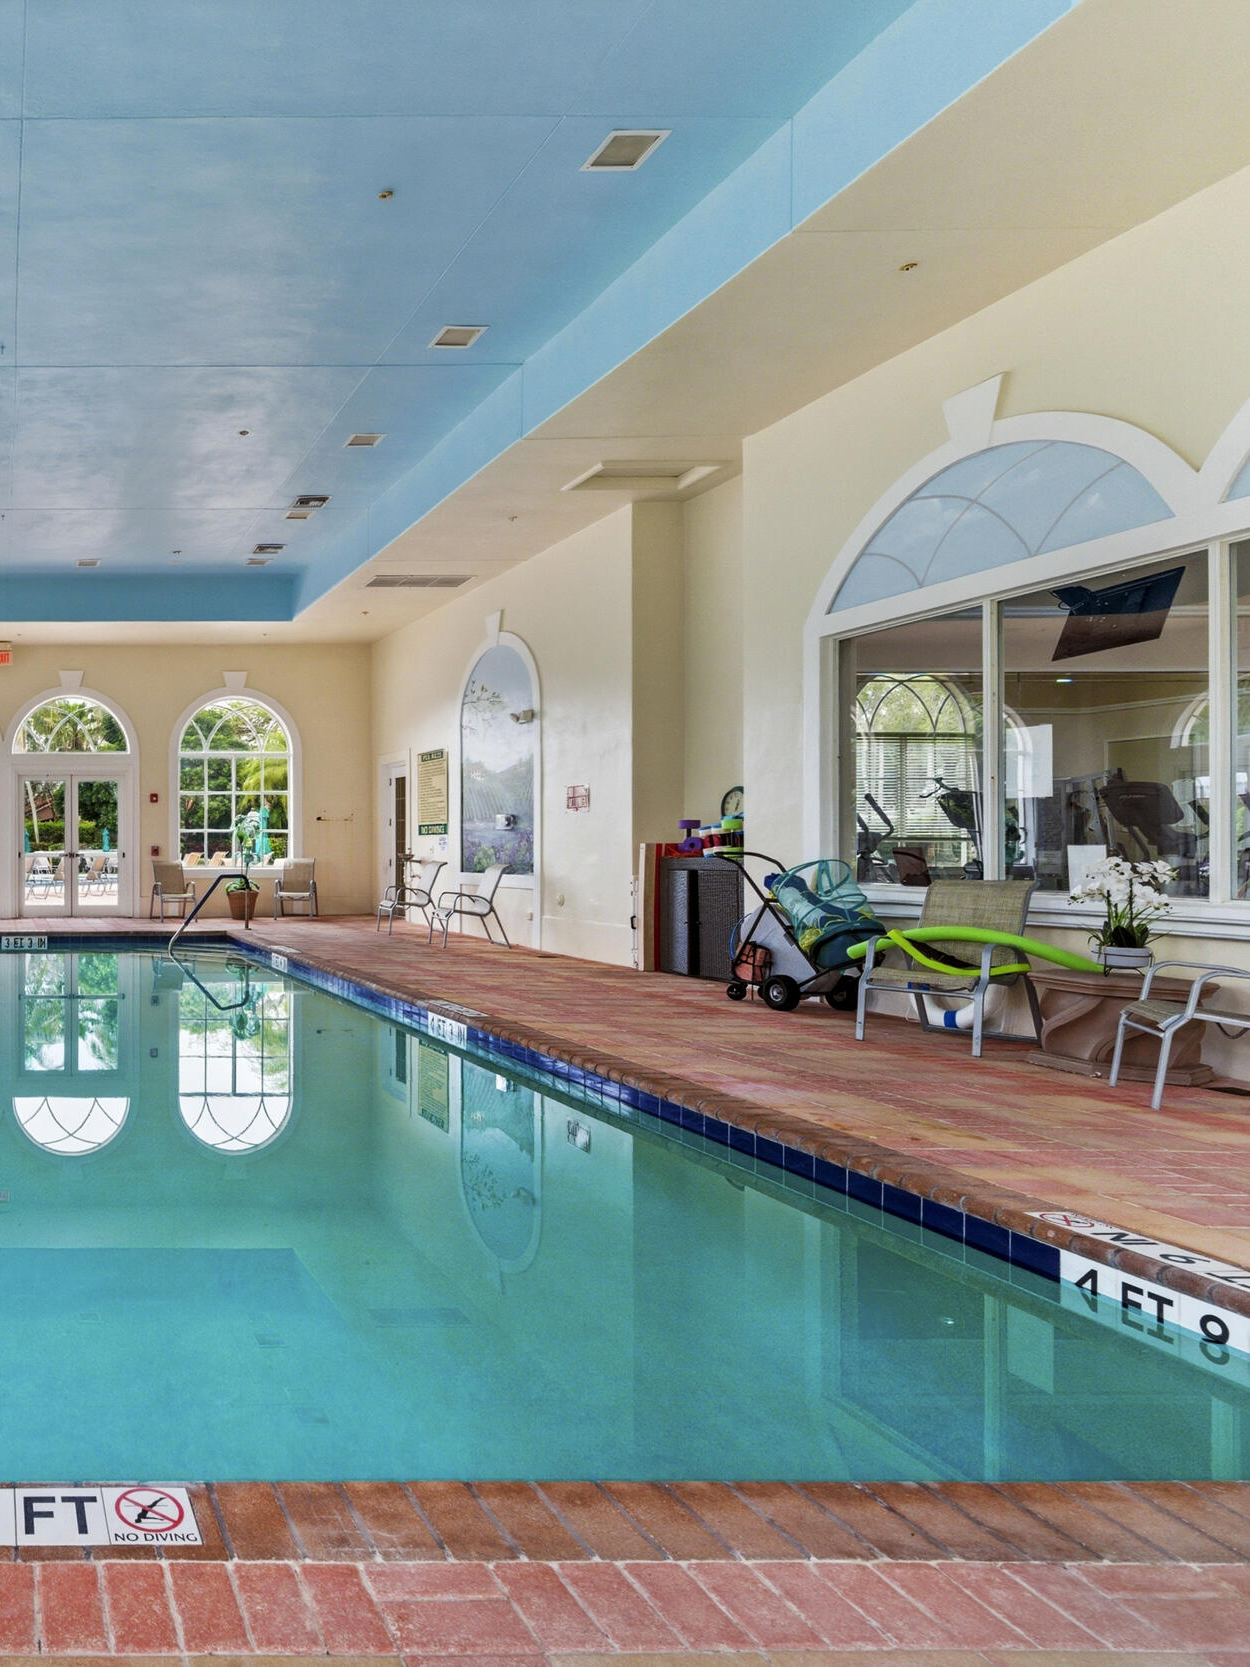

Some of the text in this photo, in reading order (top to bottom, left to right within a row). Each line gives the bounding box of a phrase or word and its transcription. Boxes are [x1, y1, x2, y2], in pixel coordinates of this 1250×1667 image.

[1121, 1281, 1174, 1324] FT
[1200, 1314, 1230, 1345] 9
[23, 1496, 98, 1535] FT
[114, 1532, 198, 1542] NO DIVING
